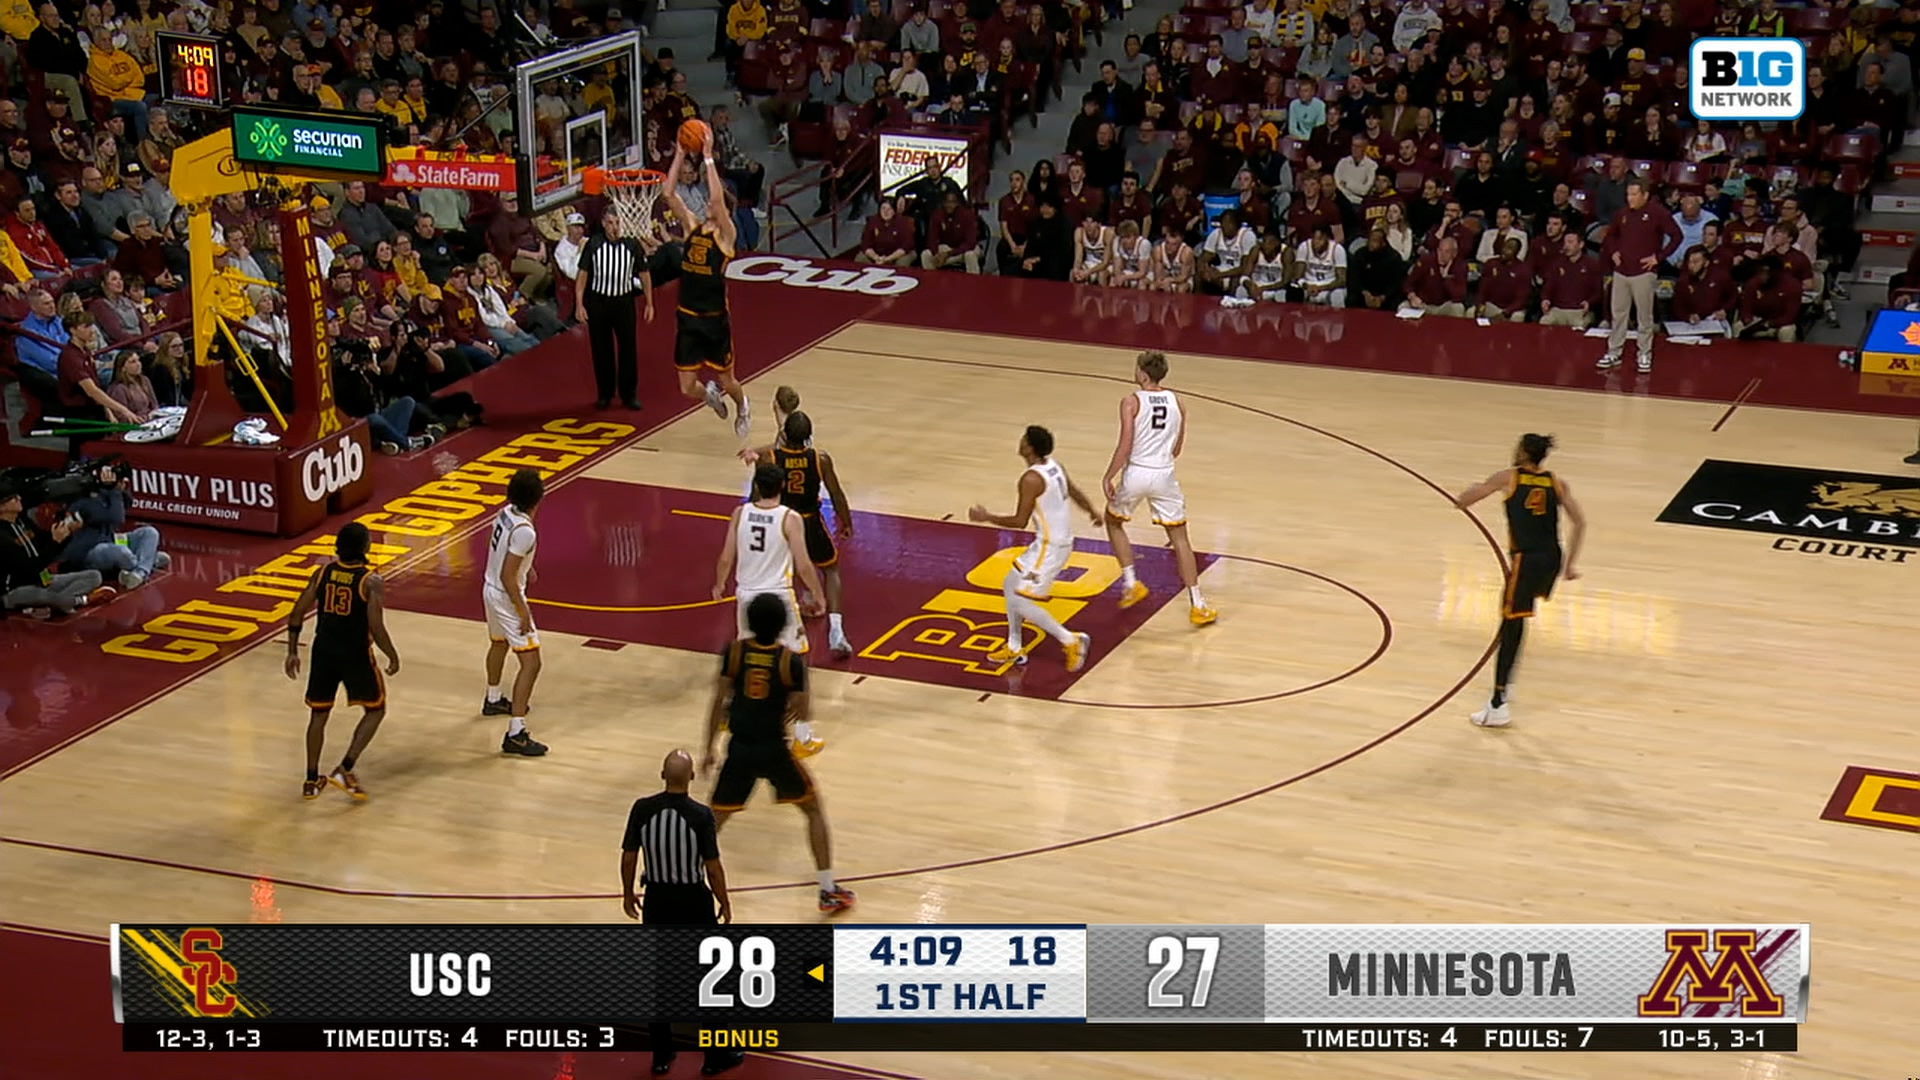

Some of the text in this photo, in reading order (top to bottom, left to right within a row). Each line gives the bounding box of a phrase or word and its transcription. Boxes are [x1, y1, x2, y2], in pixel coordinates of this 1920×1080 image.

[177, 44, 214, 67] 4:09
[186, 68, 208, 96] 18
[292, 128, 363, 150] securian
[294, 145, 343, 157] FINANCIAL
[724, 256, 919, 295] Cub
[295, 216, 333, 401] MINNESOTA
[1152, 406, 1167, 430] 2
[302, 434, 364, 502] Cub
[360, 418, 636, 537] GOPHERS
[210, 478, 275, 509] PLUS
[787, 470, 805, 495] 2
[167, 502, 203, 516] CREDIT
[205, 507, 240, 520] UNION
[1524, 488, 1547, 516] 4
[749, 525, 766, 552] 3
[1771, 537, 1917, 563] COURT
[101, 533, 412, 663] GOLDEN
[323, 583, 352, 616] 13
